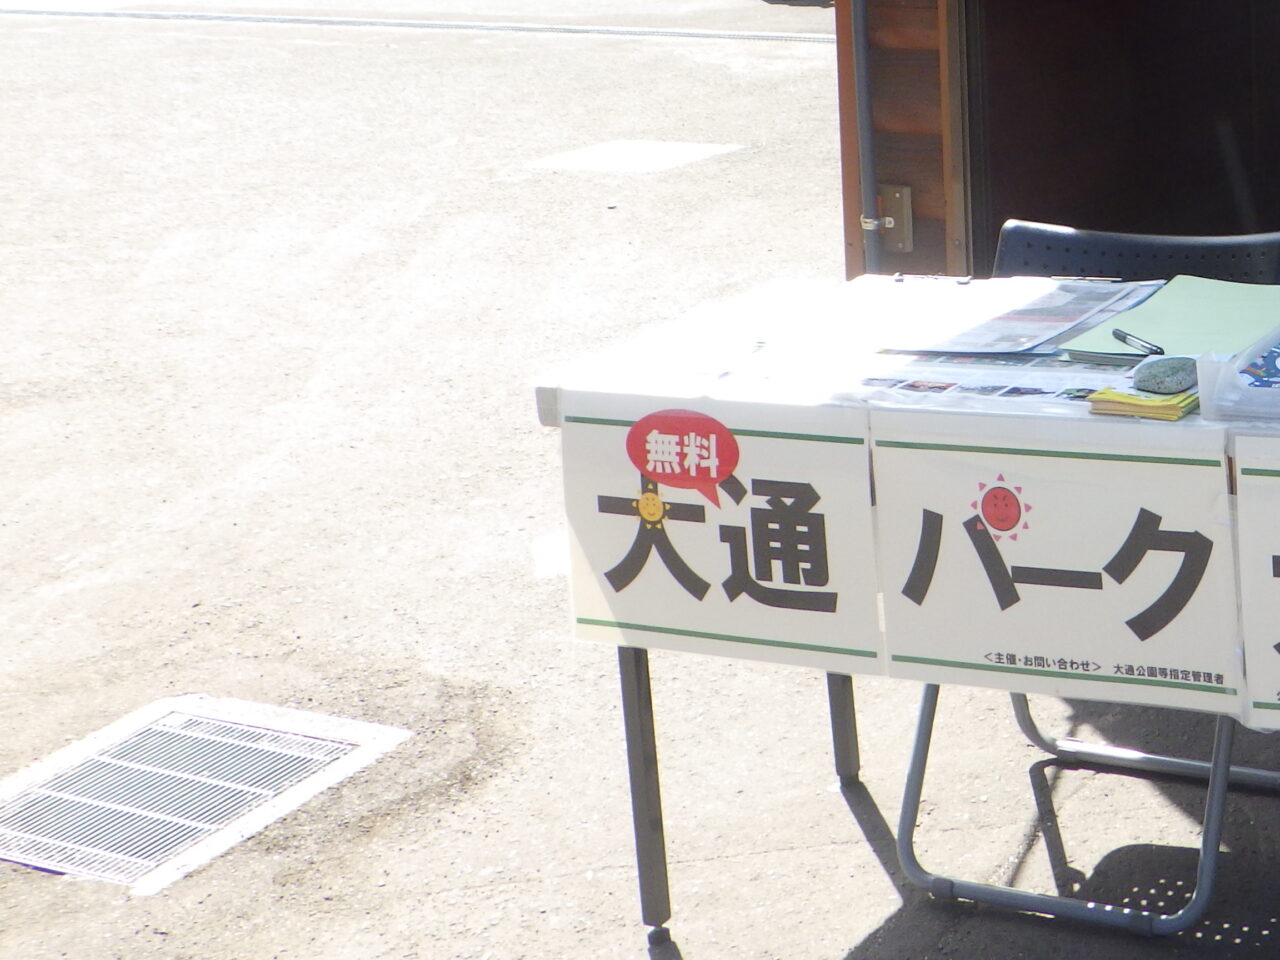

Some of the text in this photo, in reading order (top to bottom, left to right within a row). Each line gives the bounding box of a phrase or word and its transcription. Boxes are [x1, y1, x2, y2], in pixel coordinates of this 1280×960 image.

[645, 430, 719, 478] 無料
[597, 472, 838, 612] 大通
[901, 487, 1214, 642] パーク
[1113, 663, 1224, 685] 大通公園等指定管理者
